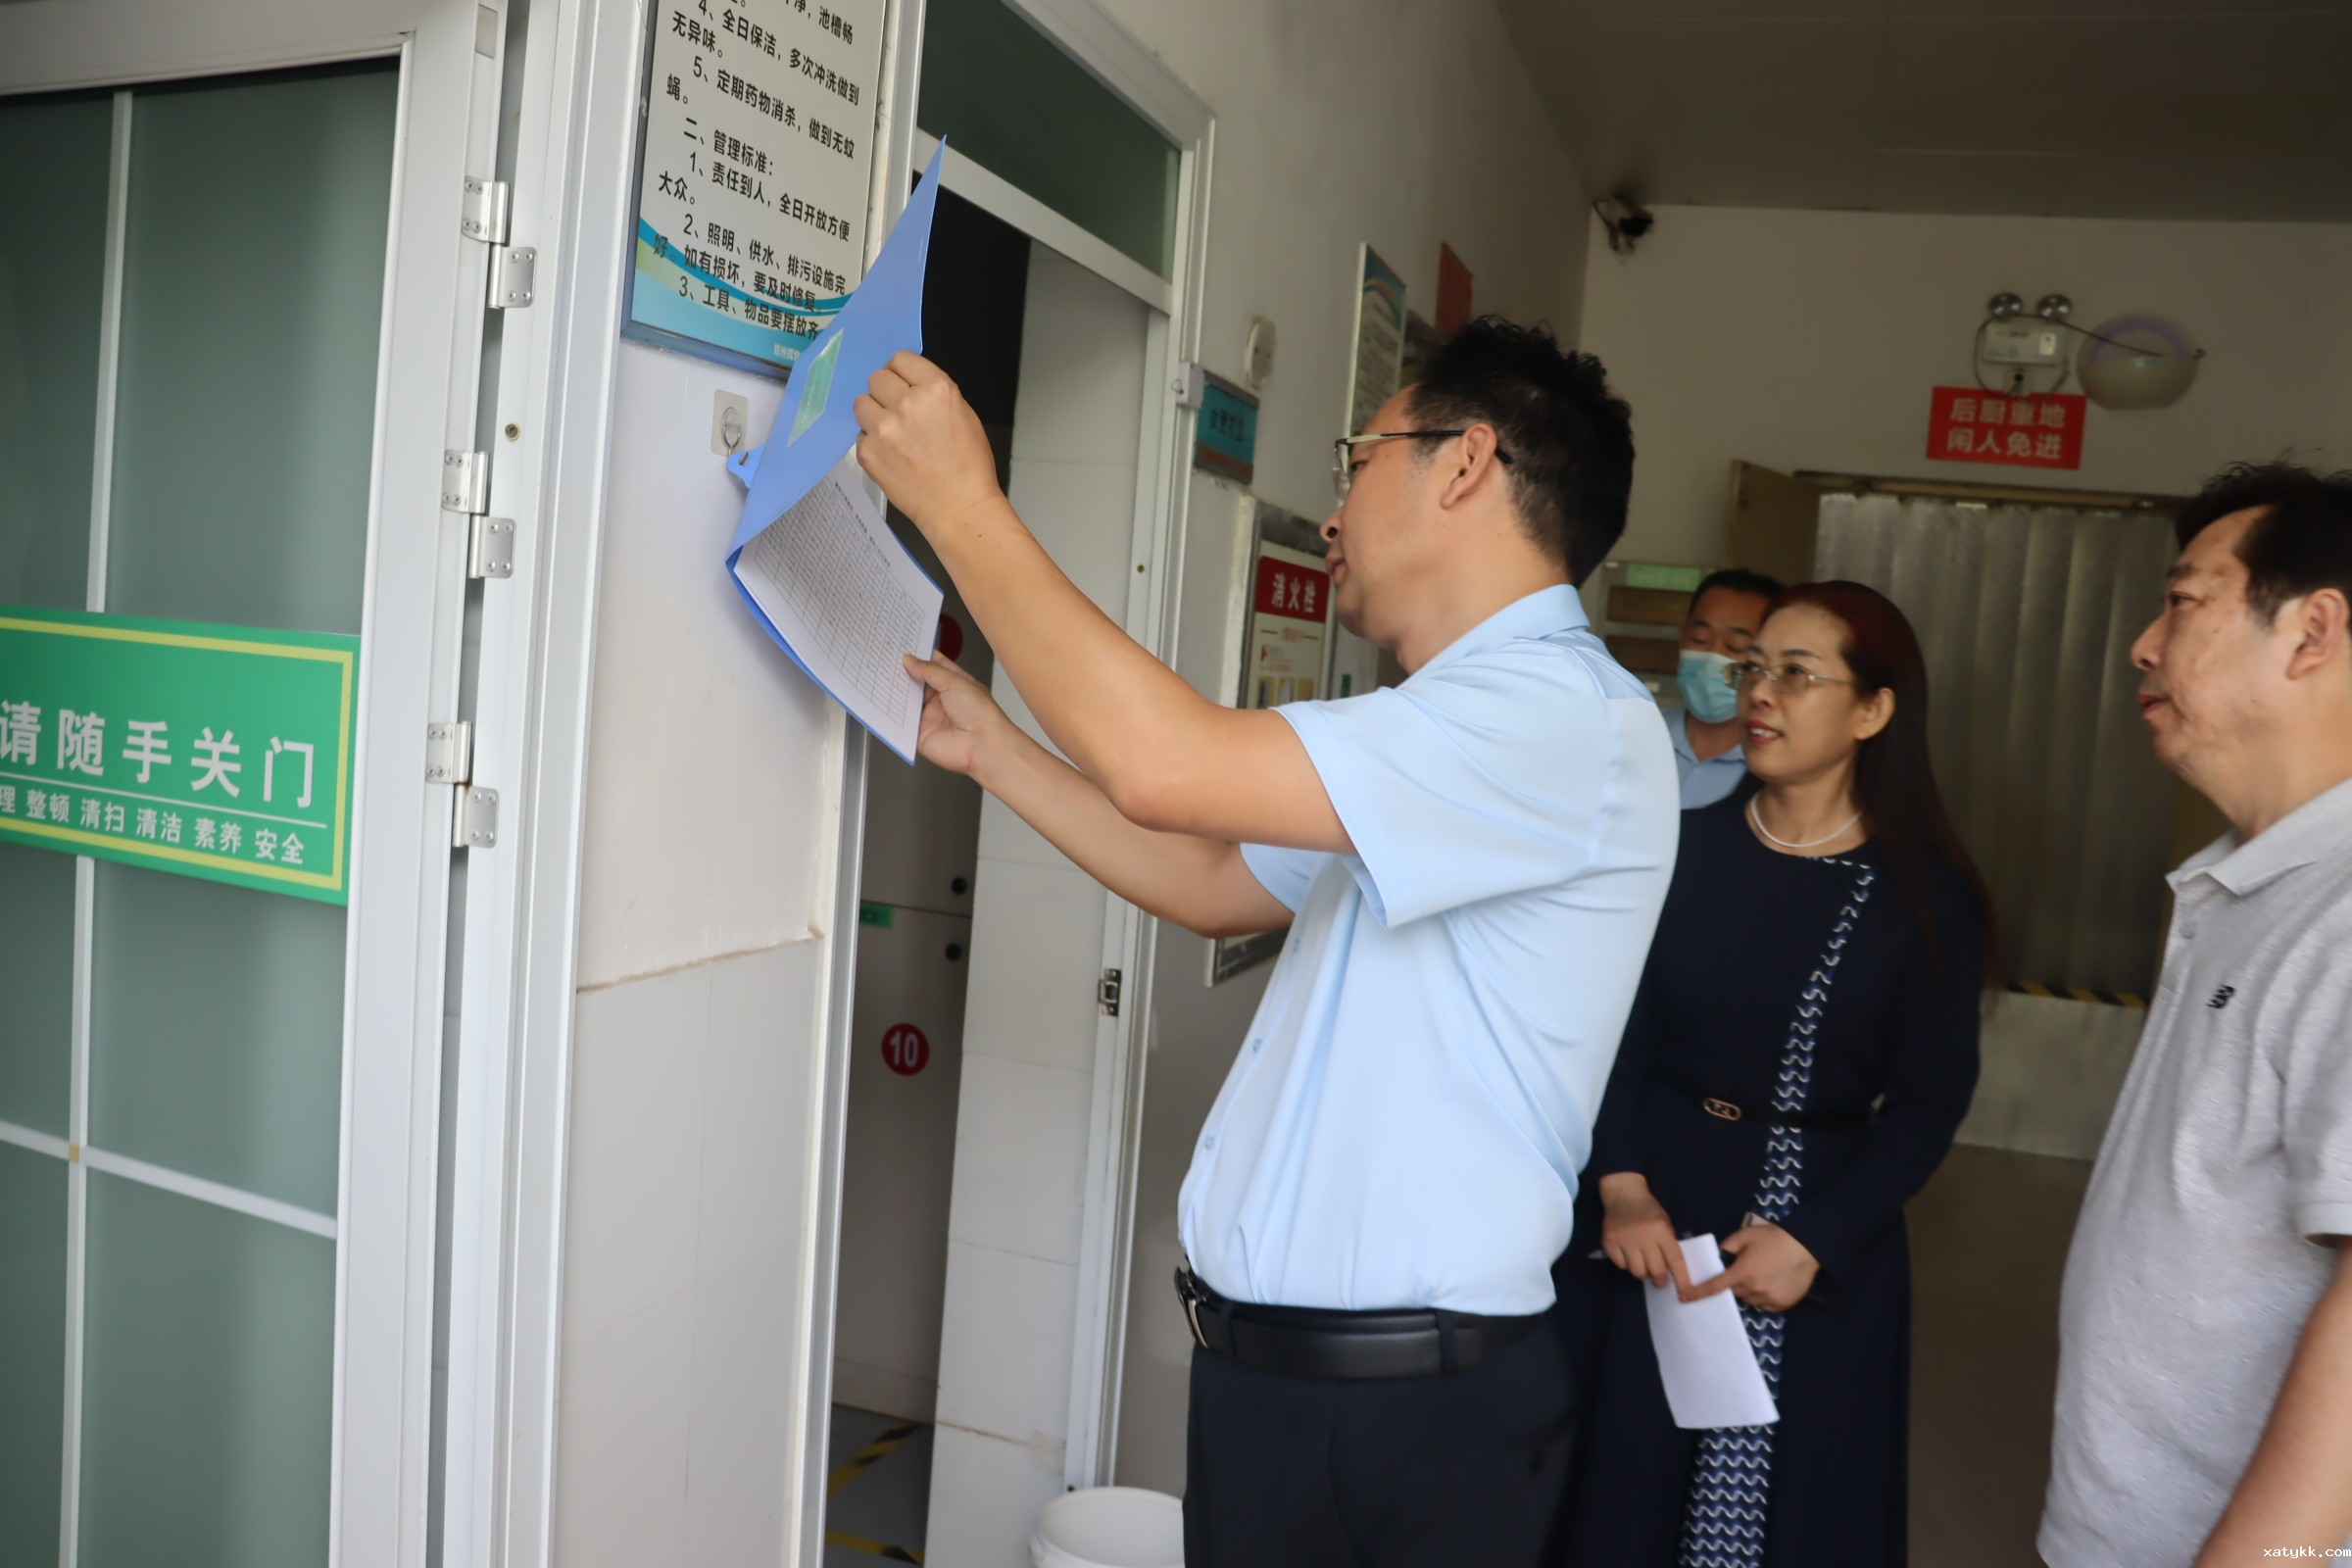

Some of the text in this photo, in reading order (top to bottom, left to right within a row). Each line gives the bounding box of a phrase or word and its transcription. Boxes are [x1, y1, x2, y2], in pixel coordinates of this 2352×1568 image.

[672, 11, 723, 58] 无异味。
[693, 56, 856, 160] 5、定期药物消杀，做到无蚊
[684, 117, 774, 175] 二、管理标准：
[659, 171, 695, 205] 大众。
[689, 151, 851, 242] 1、责任到人，全日开放方便
[683, 214, 847, 296] 2、照明、供水、排污设施完
[1948, 397, 2066, 429] 后厨重地
[1946, 427, 2063, 460] 闲人免进
[1271, 572, 1316, 613] 消火栓
[0, 700, 315, 808] 请随手关门
[25, 788, 71, 823] 整顿
[80, 797, 125, 833] 清扫
[135, 807, 182, 844] 清洁
[194, 817, 242, 854] 素养
[255, 828, 306, 864] 安全
[889, 1031, 919, 1067] 10
